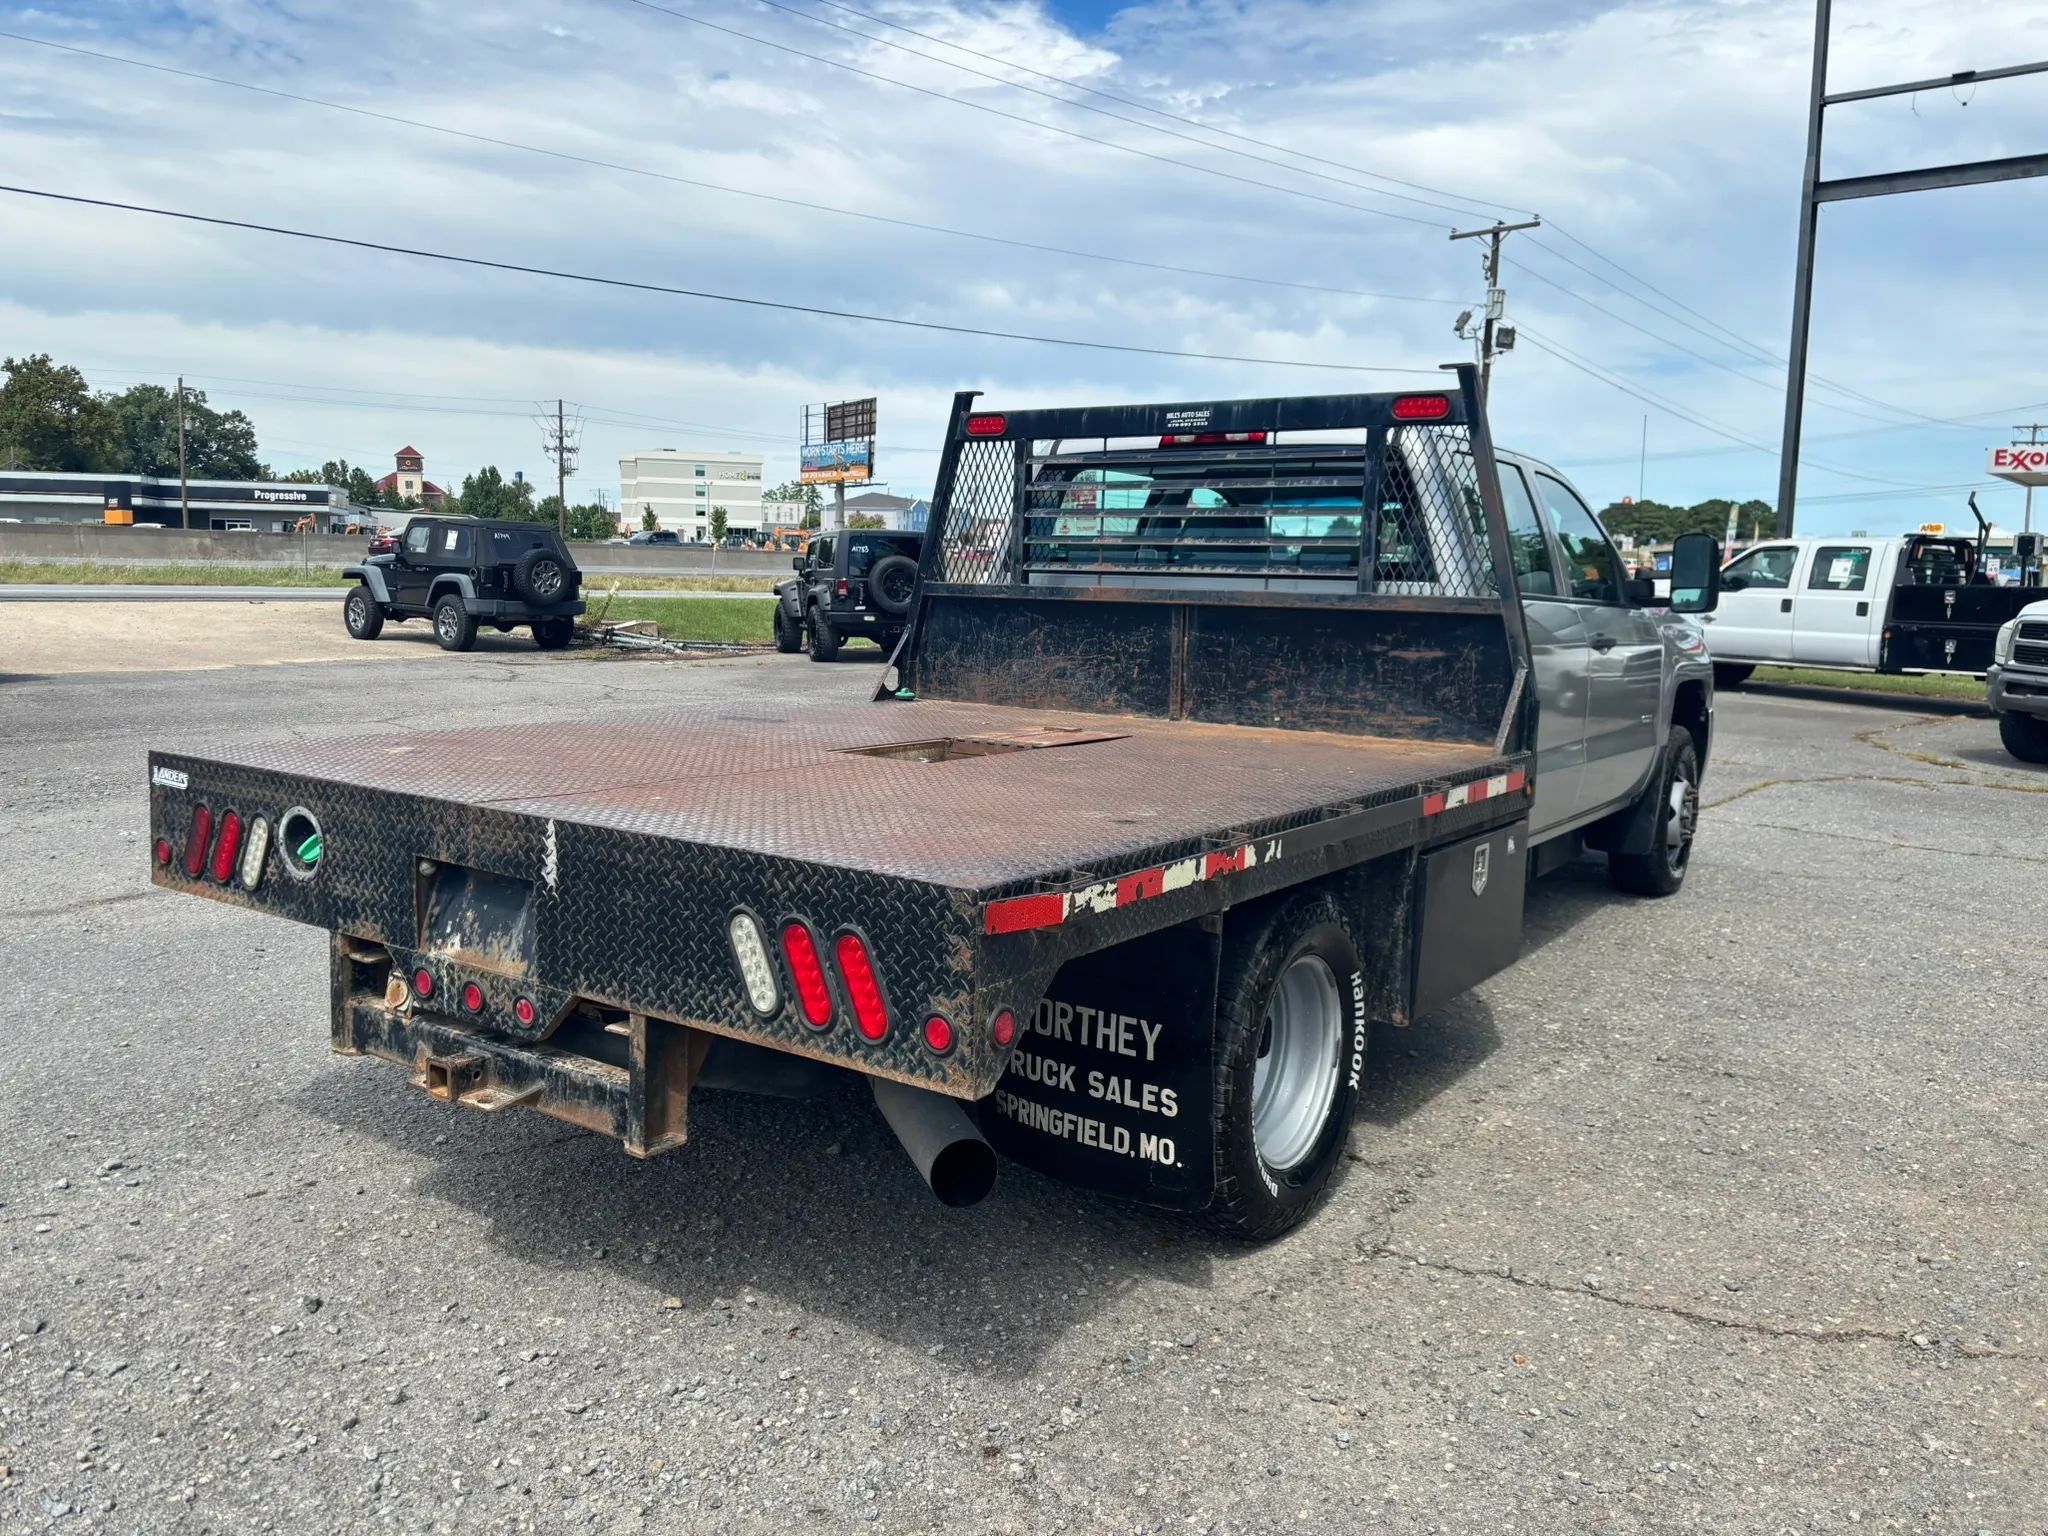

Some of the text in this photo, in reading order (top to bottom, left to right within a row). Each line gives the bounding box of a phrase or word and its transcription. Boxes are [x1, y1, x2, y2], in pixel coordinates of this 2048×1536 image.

[801, 446, 820, 458] WORK
[821, 443, 846, 456] STARTS
[1994, 449, 2048, 471] EXXO
[254, 489, 308, 502] Progressive
[1025, 998, 1163, 1061] ORTHEY
[1008, 1048, 1179, 1118] RUCK SALES
[1139, 1132, 1182, 1168] MO.
